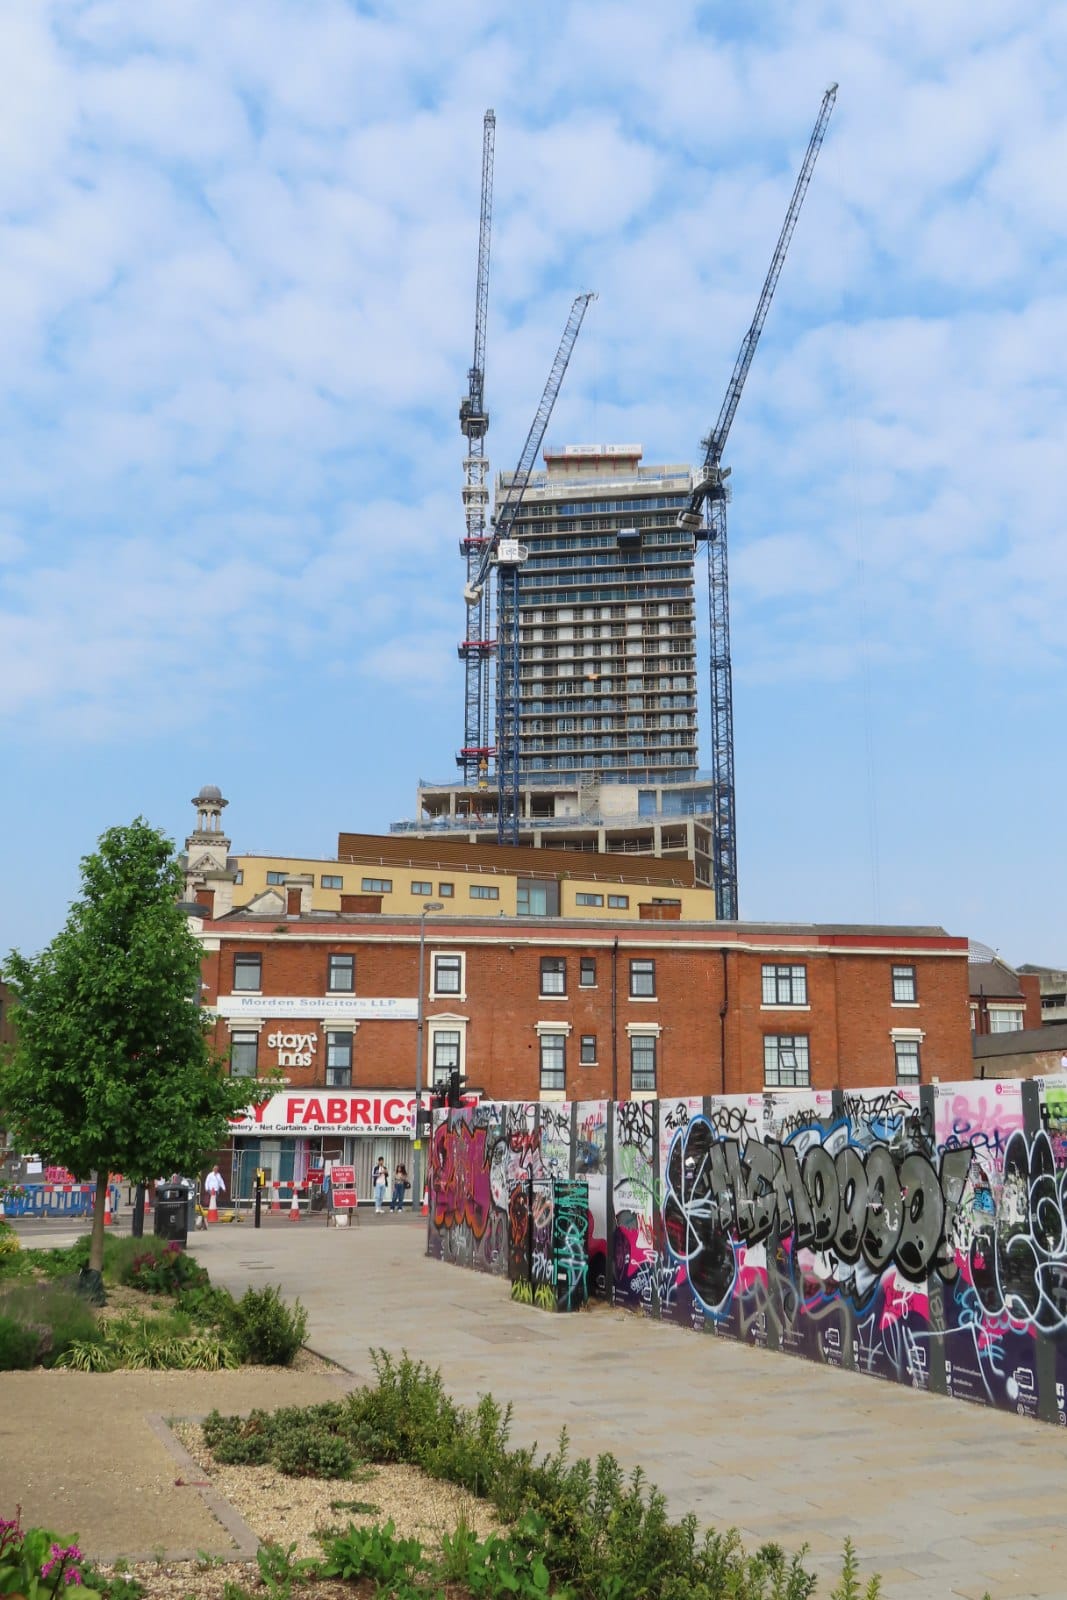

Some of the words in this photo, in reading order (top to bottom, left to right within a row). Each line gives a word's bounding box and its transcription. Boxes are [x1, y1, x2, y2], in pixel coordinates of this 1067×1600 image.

[299, 998, 366, 1007] Solicitors
[371, 999, 397, 1007] LLP
[259, 1123, 273, 1131] Net
[275, 1123, 307, 1132] Curtains
[313, 1124, 335, 1132] Dress
[337, 1124, 364, 1132] Fabrics
